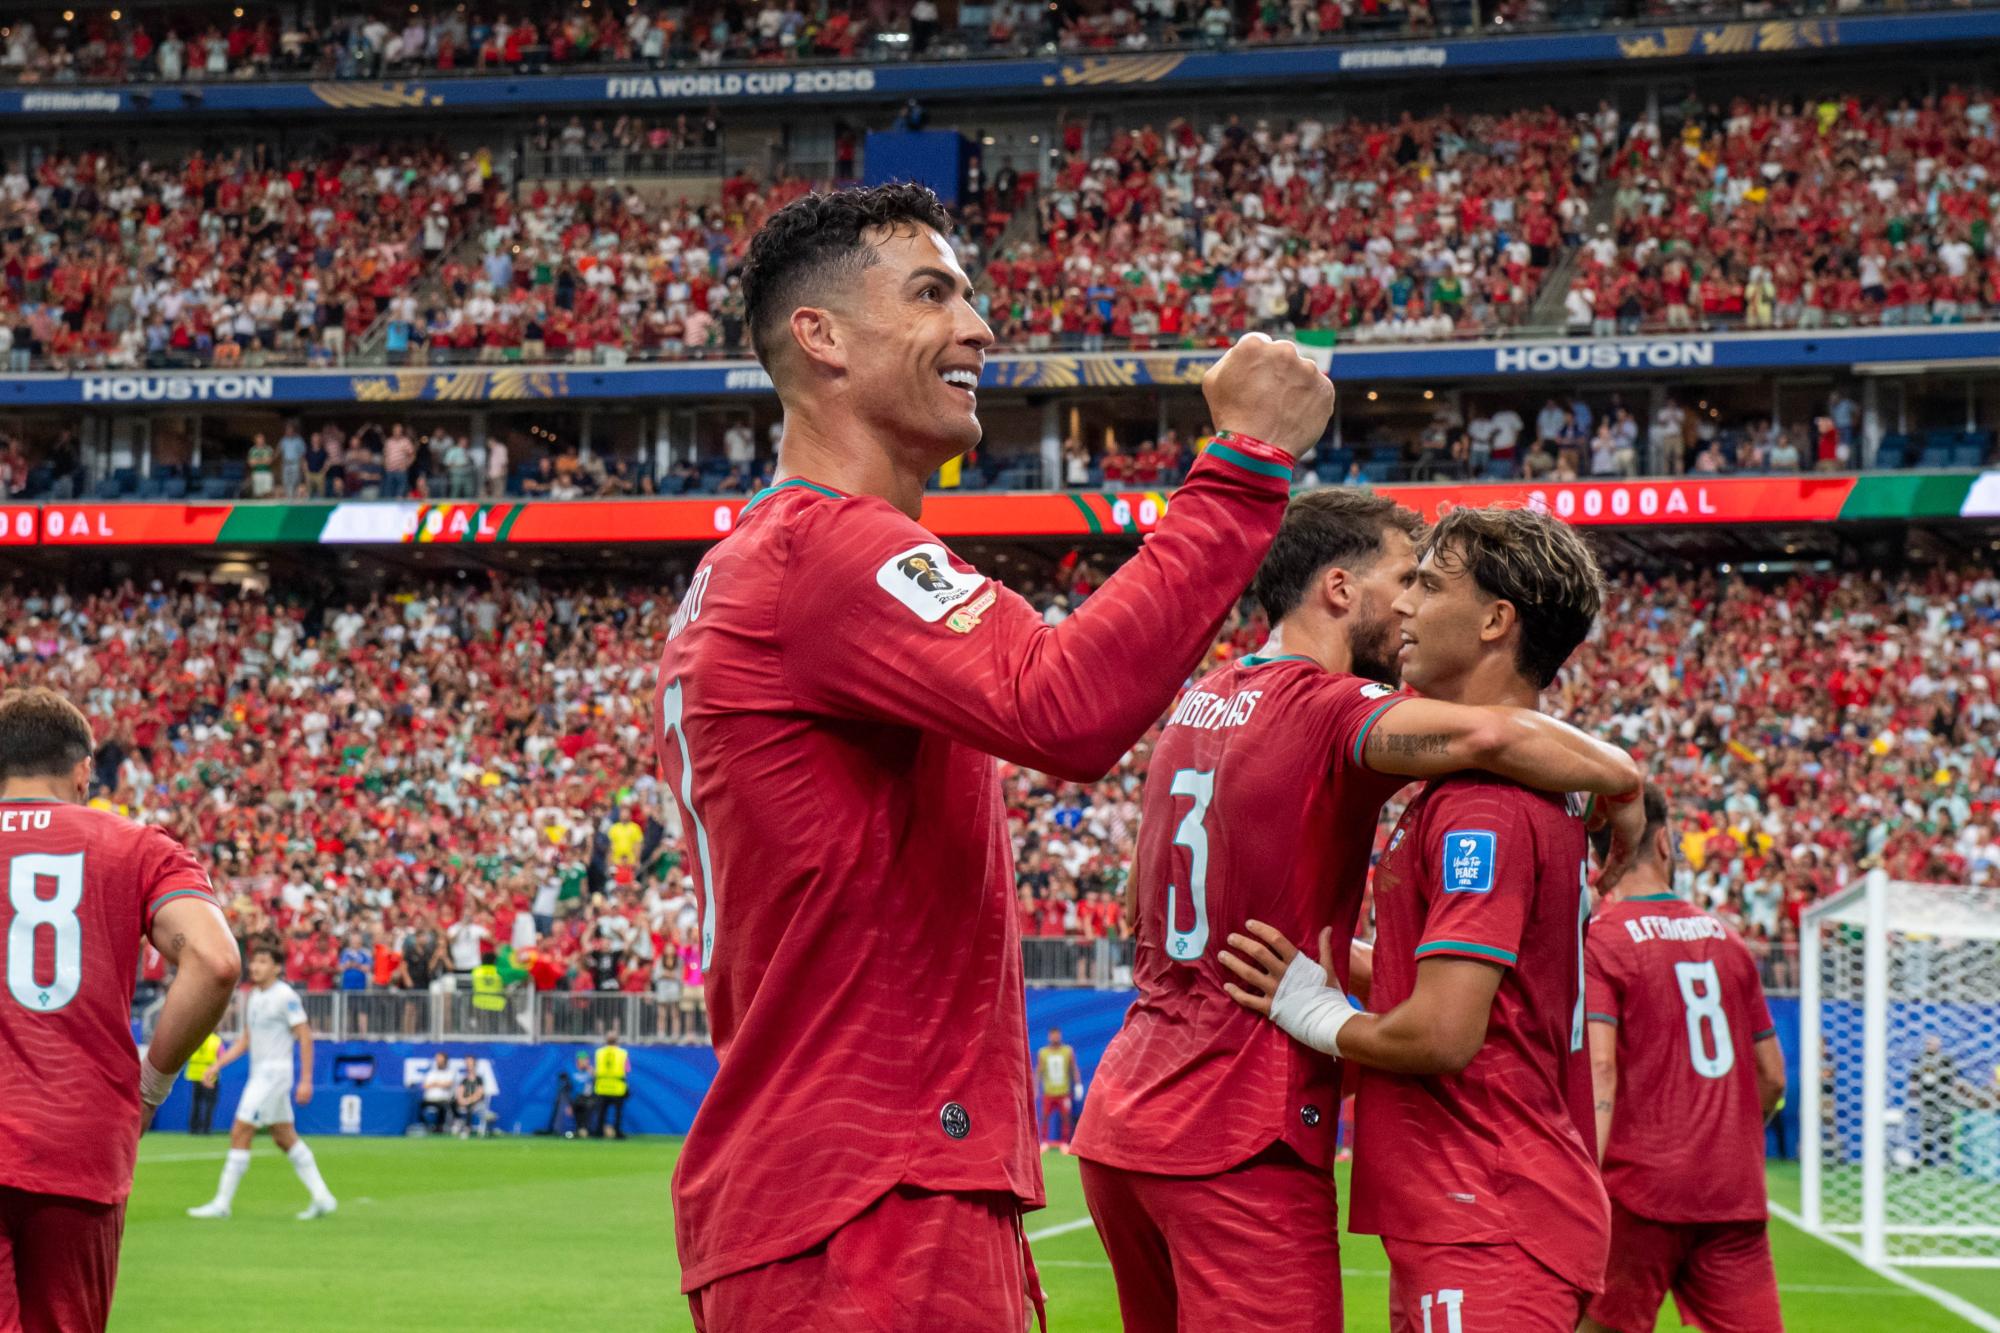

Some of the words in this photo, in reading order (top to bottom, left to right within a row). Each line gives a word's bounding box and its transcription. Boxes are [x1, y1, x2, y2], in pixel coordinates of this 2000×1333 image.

[606, 78, 655, 98] FIFA
[658, 74, 742, 97] WORLD
[745, 73, 792, 93] CUP
[793, 70, 875, 92] 2026
[1495, 342, 1714, 372] HOUSTON
[82, 376, 273, 400] HOUSTON
[0, 810, 51, 832] ETO
[1166, 768, 1216, 960] 3
[1455, 867, 1479, 879] PEACE
[6, 850, 85, 1013] 8
[1674, 960, 1735, 1079] 8
[403, 1057, 499, 1096] FFA
